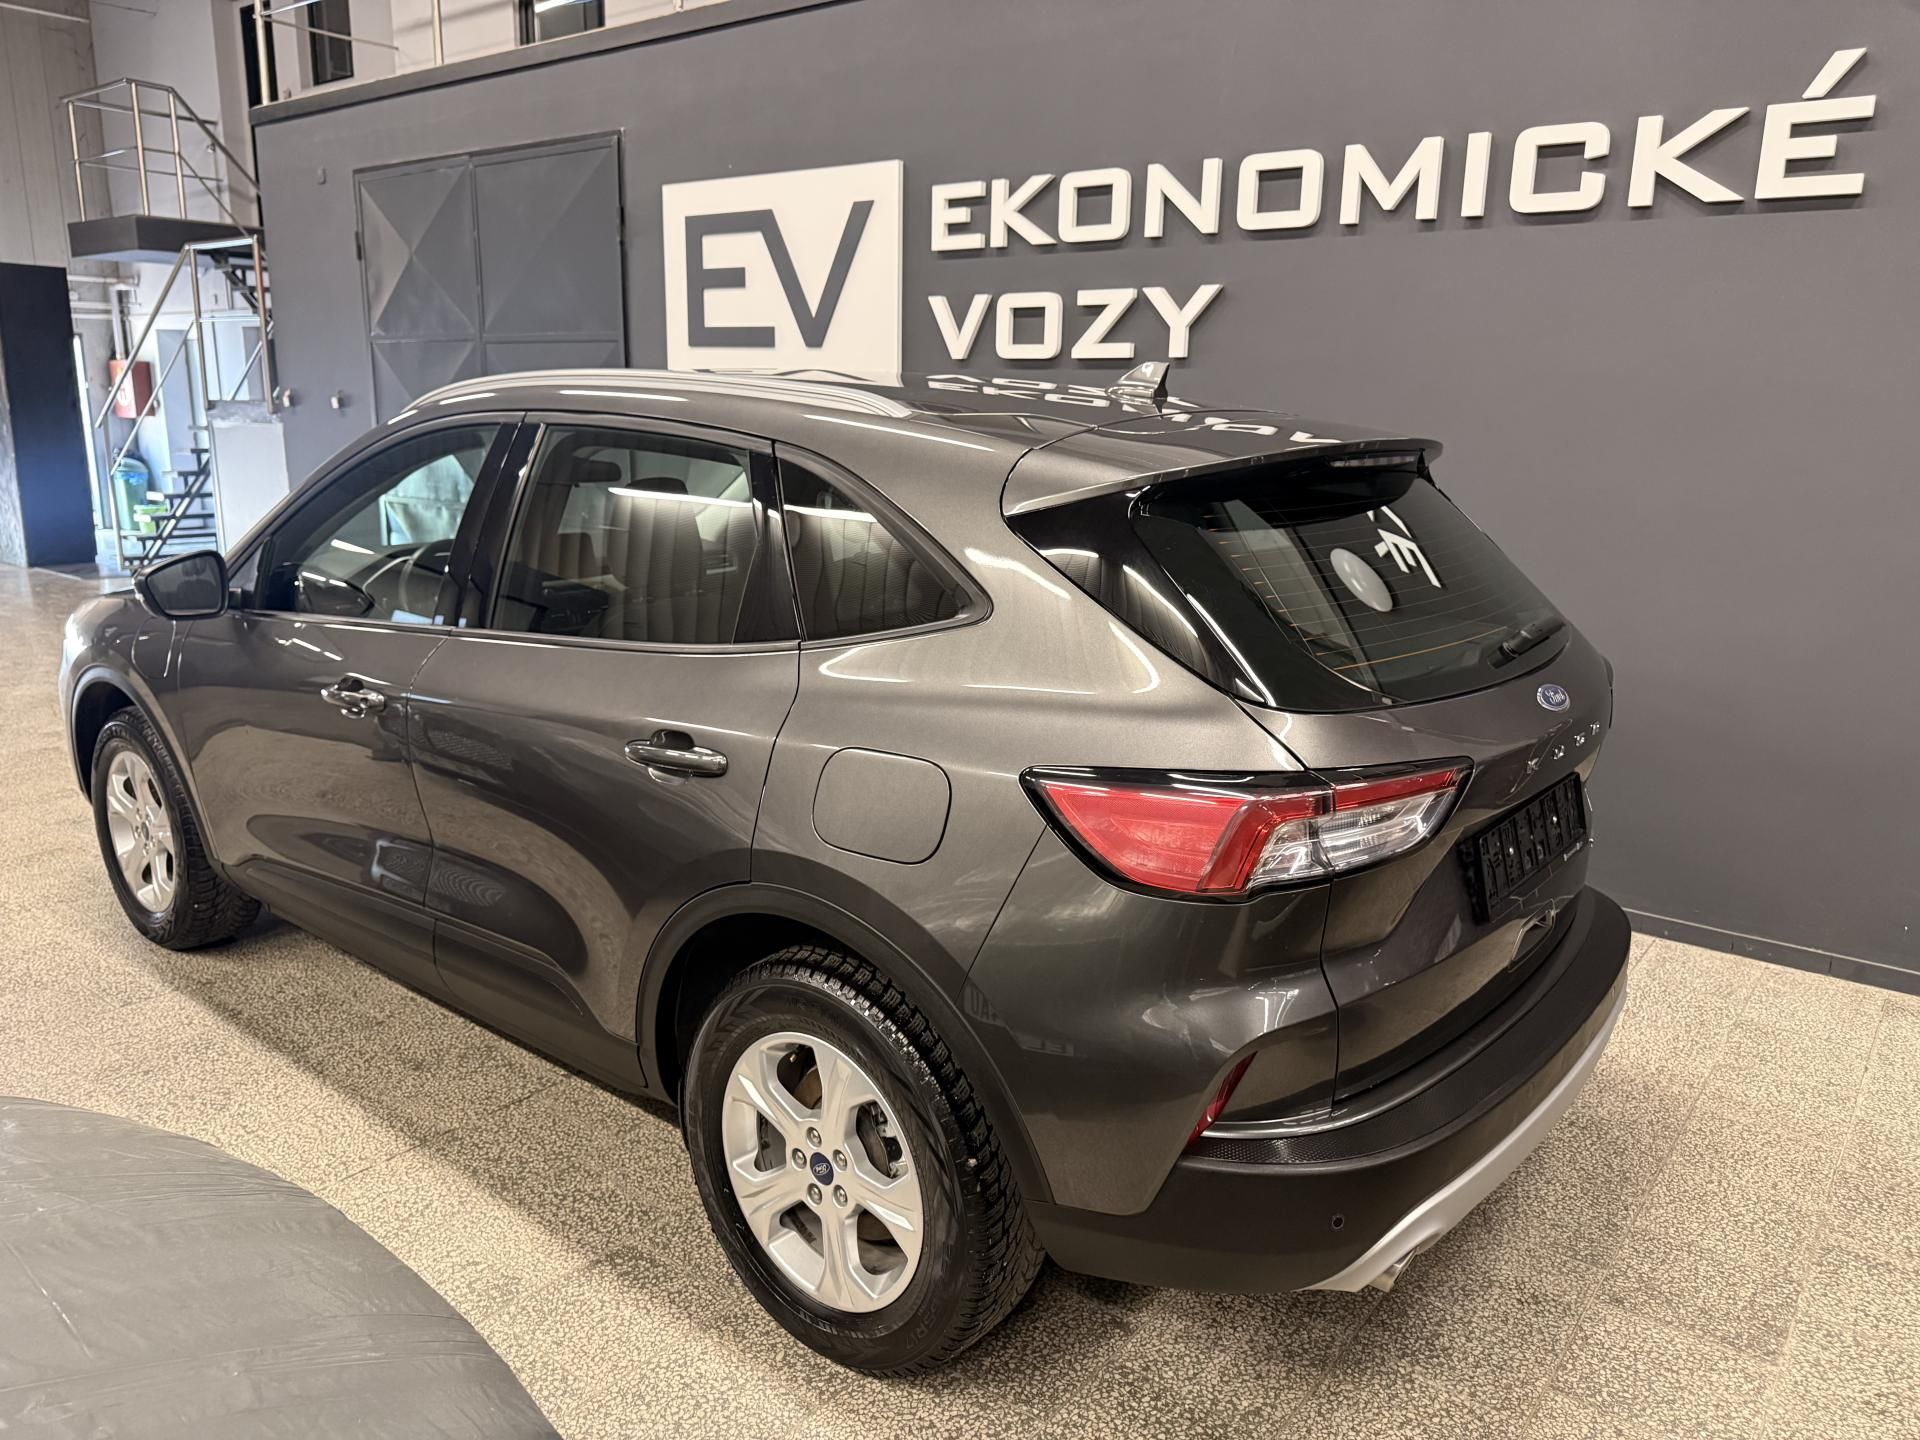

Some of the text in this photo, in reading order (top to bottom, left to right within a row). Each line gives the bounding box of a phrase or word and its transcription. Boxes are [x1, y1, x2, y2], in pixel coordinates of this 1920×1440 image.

[930, 47, 1877, 252] EKONOMICKÉ
[685, 200, 875, 348] EV
[927, 284, 1224, 360] VOZY
